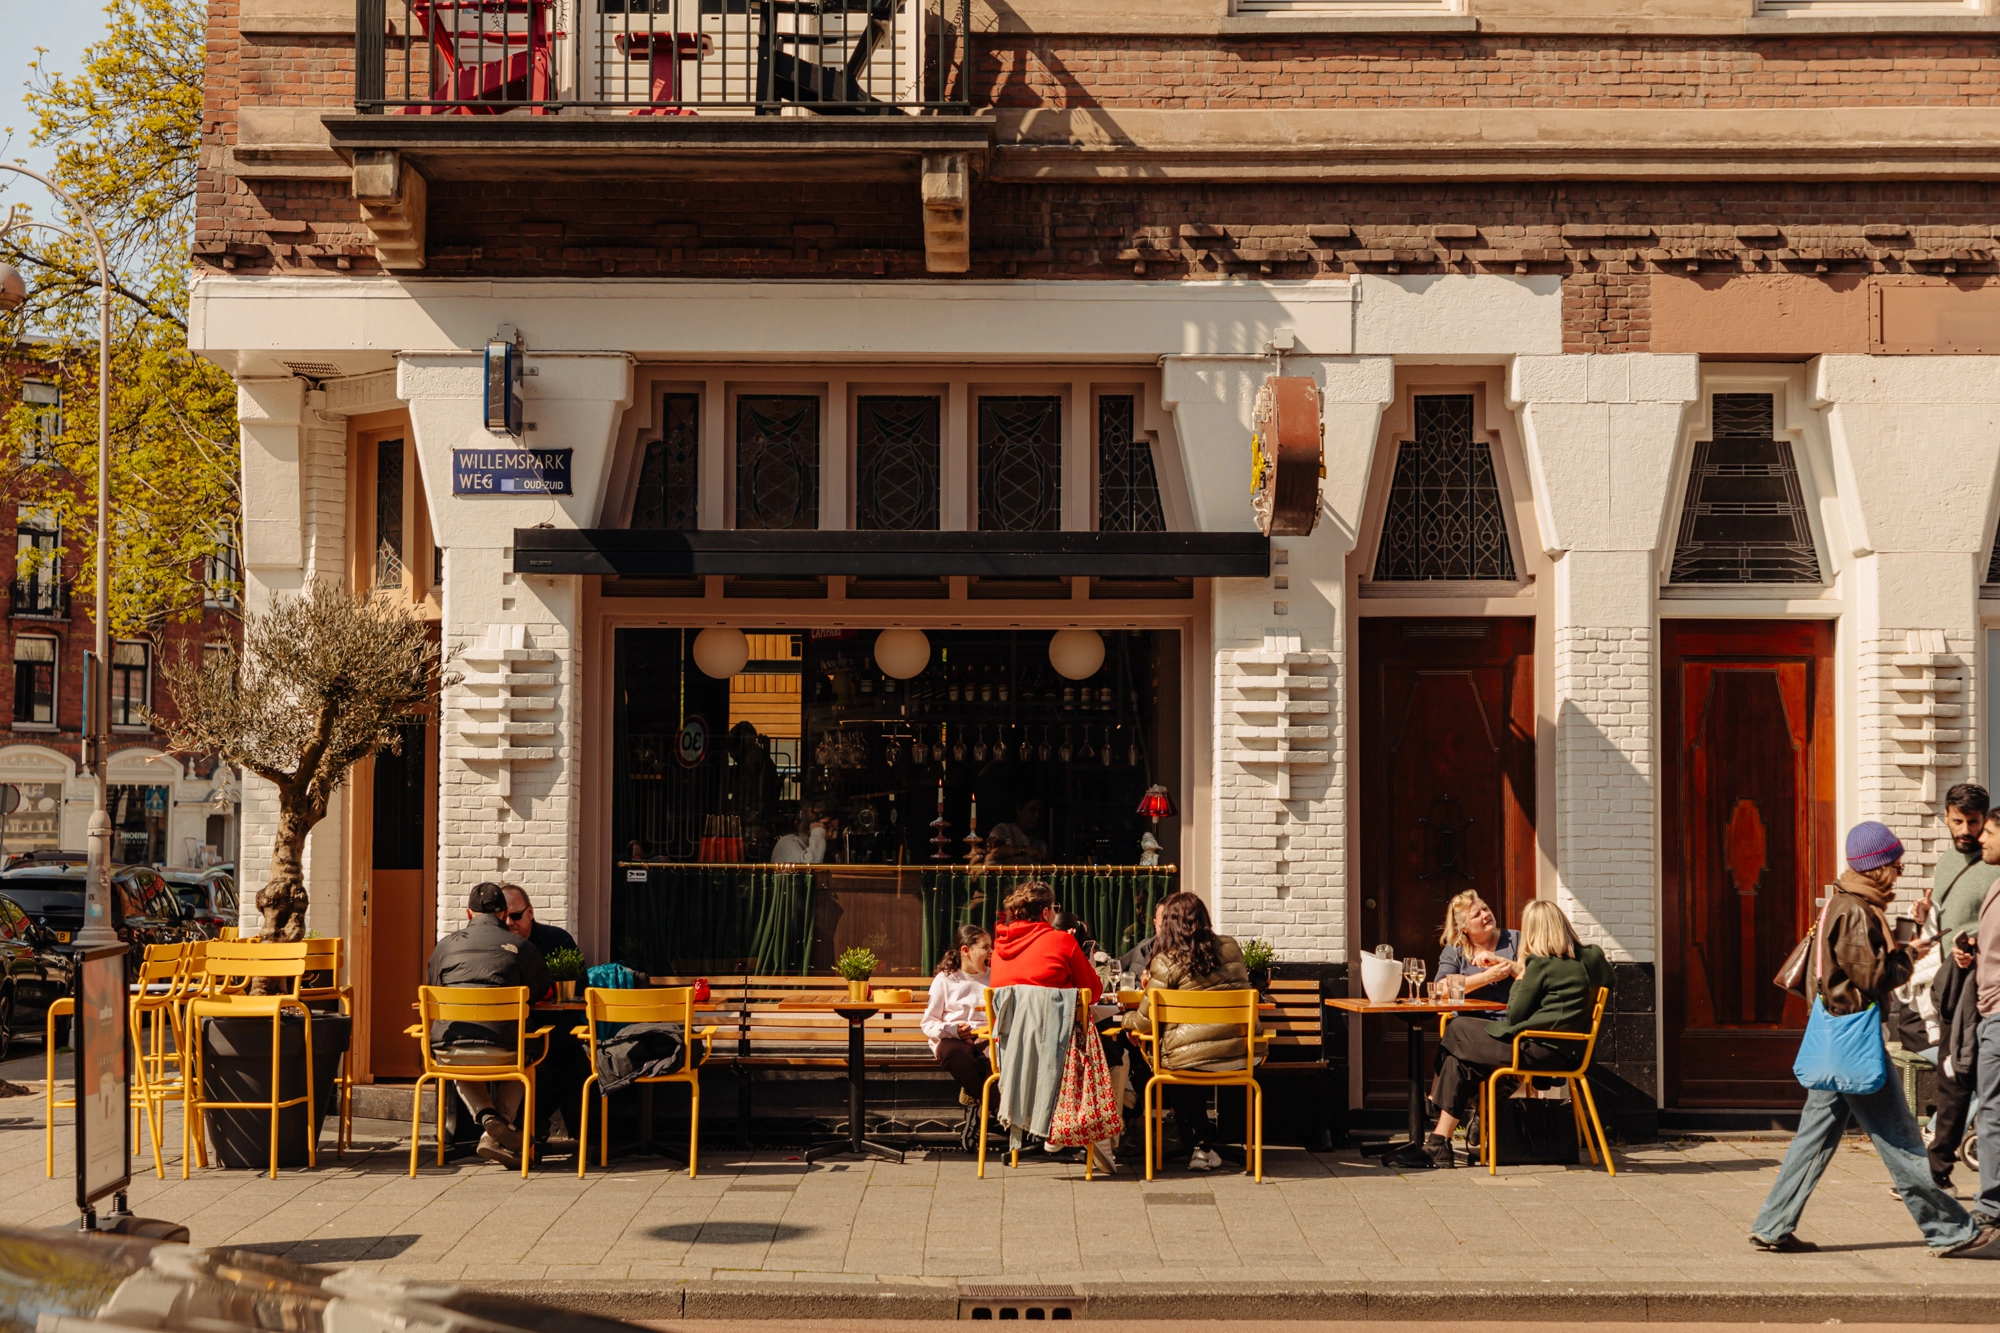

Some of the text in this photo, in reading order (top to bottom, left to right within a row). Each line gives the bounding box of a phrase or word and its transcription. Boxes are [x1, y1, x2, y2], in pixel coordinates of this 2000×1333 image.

[459, 453, 565, 470] WILLEMSPARK
[459, 473, 493, 489] WEG
[523, 479, 564, 490] OUD-ZUID
